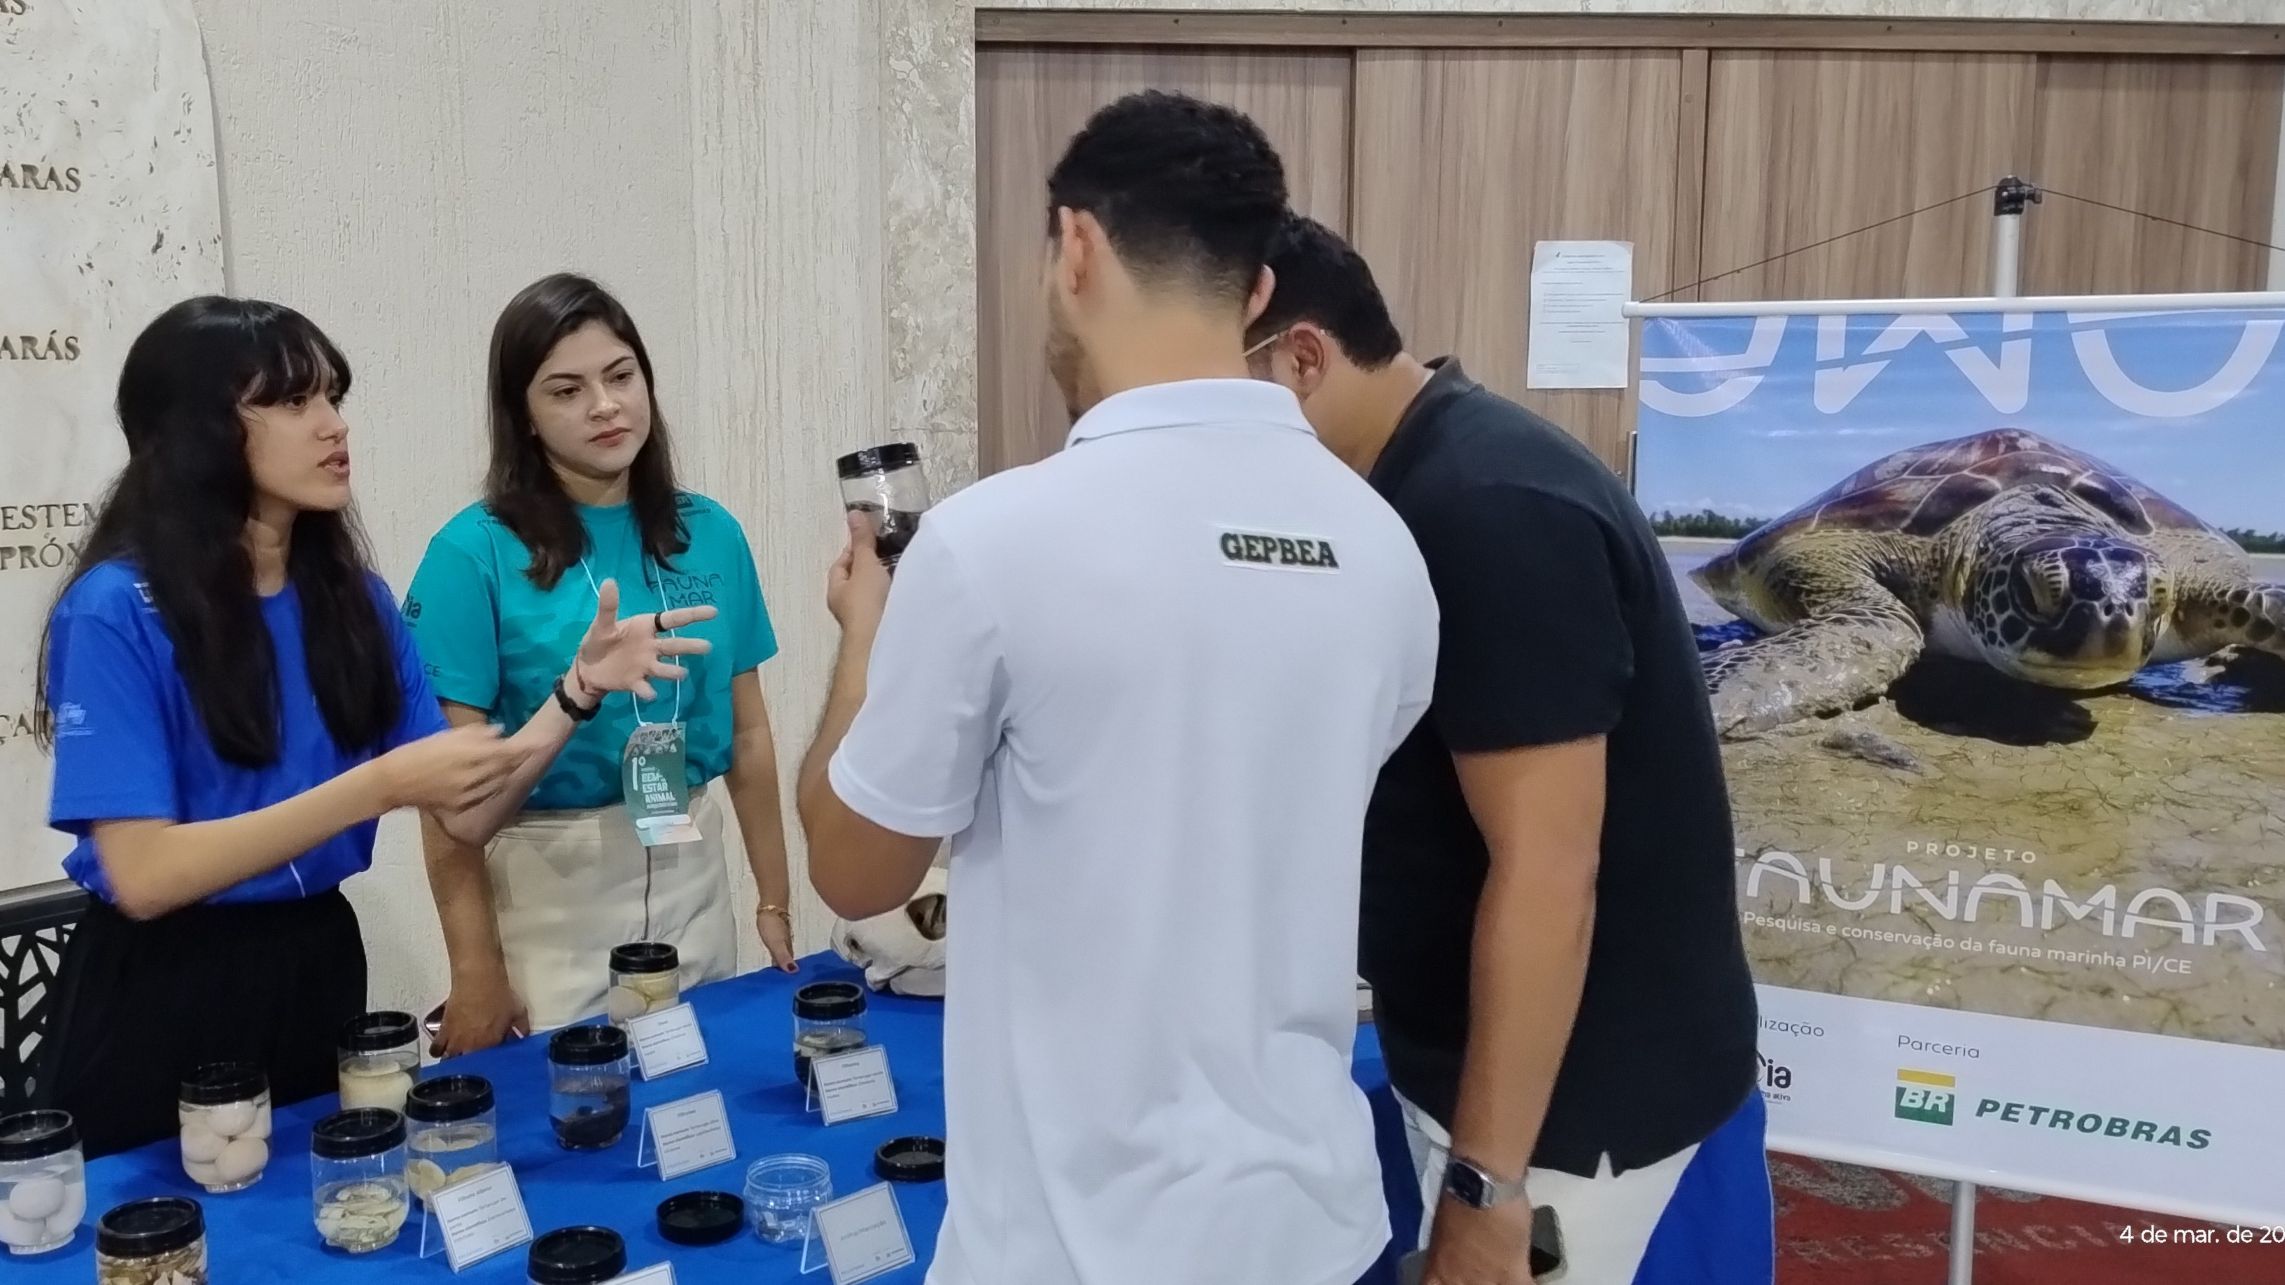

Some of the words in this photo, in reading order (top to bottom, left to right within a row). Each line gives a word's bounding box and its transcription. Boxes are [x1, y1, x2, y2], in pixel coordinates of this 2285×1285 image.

[1220, 532, 1340, 568] GEPBEA
[645, 792, 676, 803] ANIMAL
[1906, 840, 2038, 864] PROJETO
[1735, 848, 2267, 951] AUNAMAR
[1743, 911, 1821, 935] Pesquisa
[1825, 921, 1837, 935] e
[1841, 925, 1955, 951] conservação
[1959, 936, 1983, 953] da
[1988, 939, 2042, 958] fauna
[2047, 948, 2127, 968] marinha
[2132, 954, 2193, 975] PI/CE
[1897, 1034, 1981, 1059] Parceria
[1900, 1088, 1950, 1113] BR
[1975, 1098, 2212, 1150] PETROBRAS
